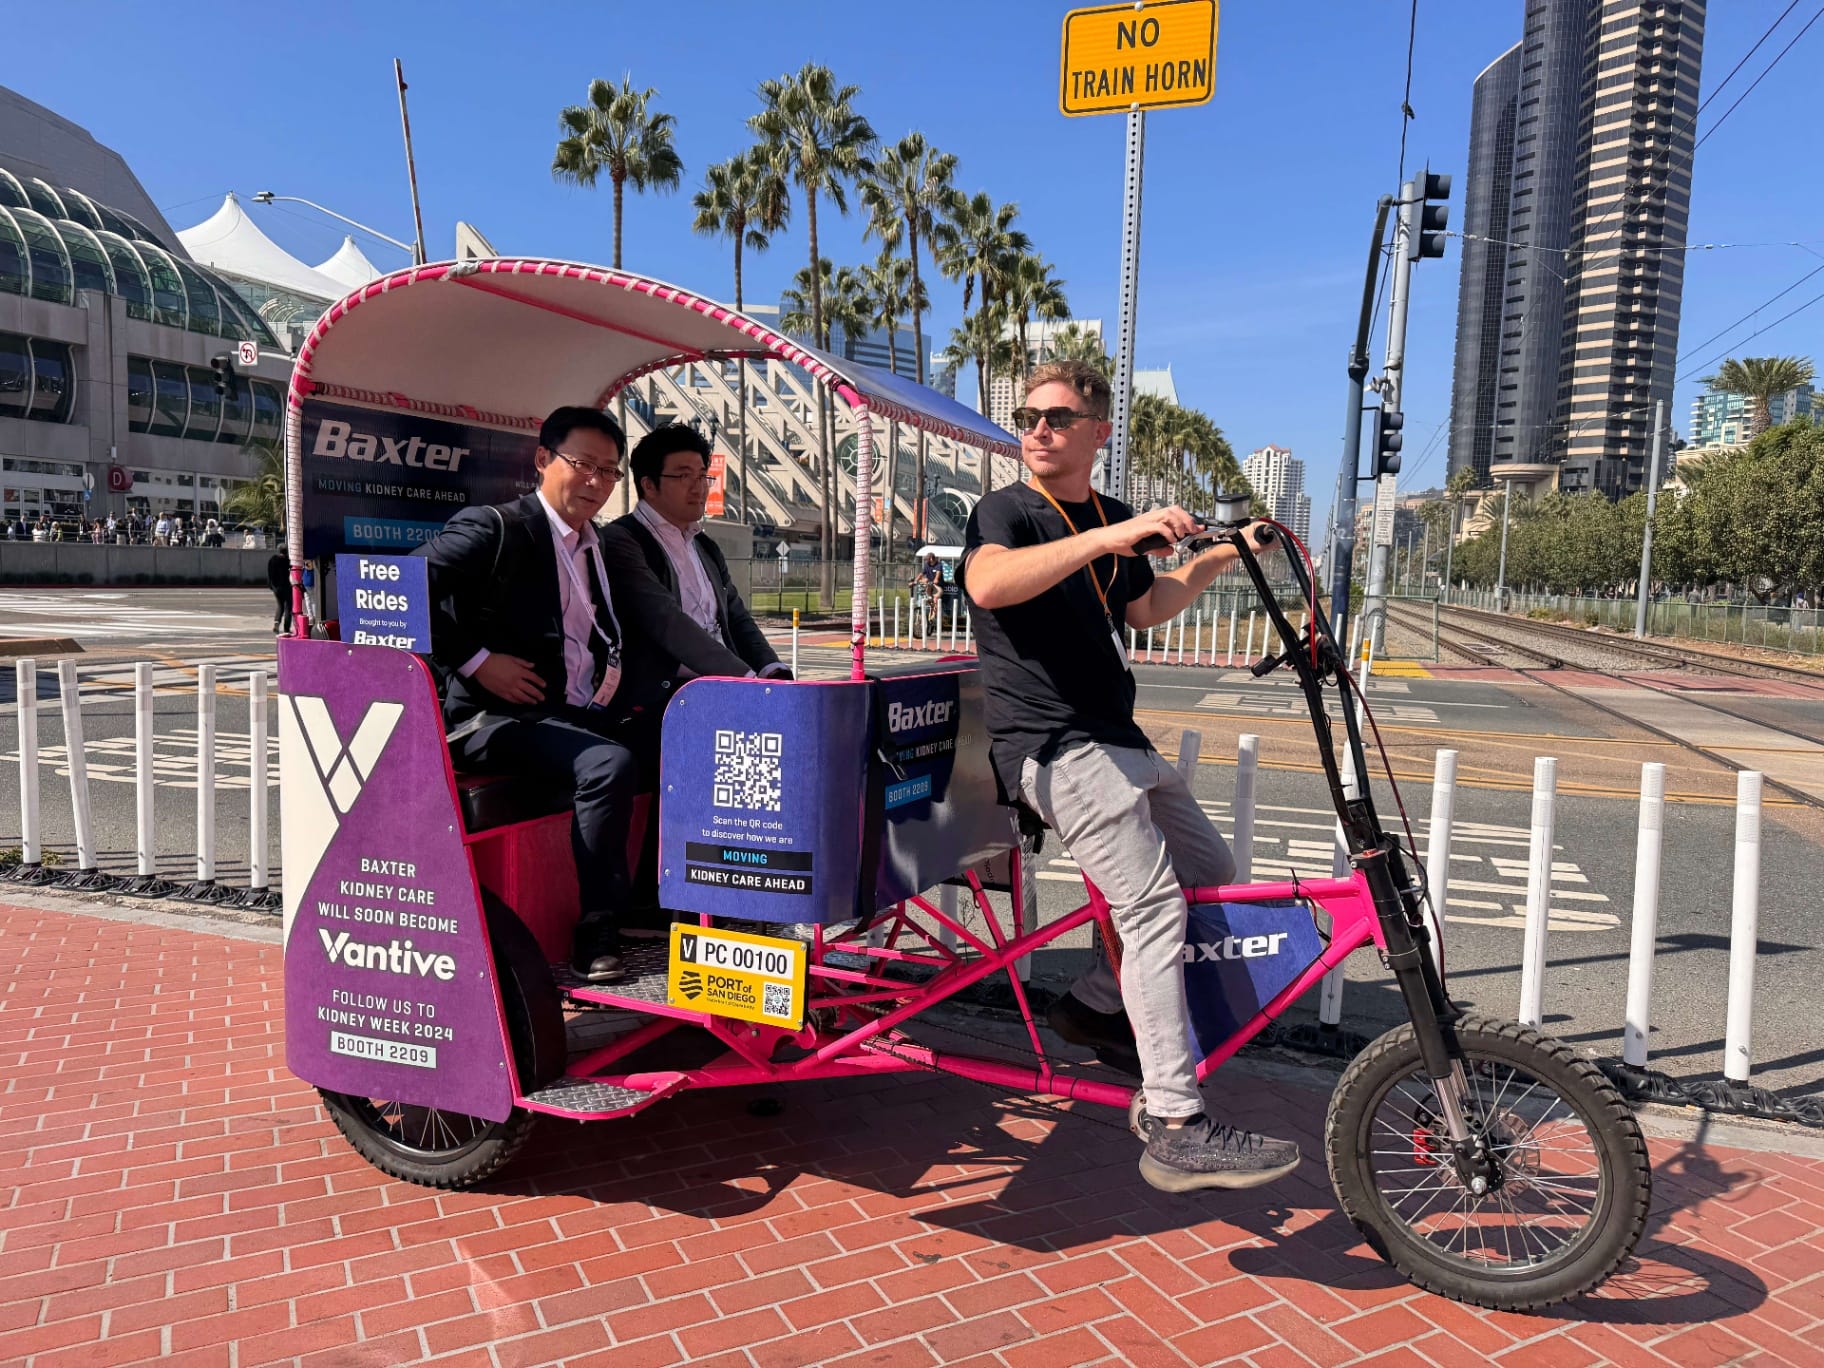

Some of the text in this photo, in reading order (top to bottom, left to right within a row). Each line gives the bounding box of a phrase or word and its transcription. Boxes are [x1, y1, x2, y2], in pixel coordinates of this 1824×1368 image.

[1117, 18, 1160, 50] NO
[1072, 58, 1206, 99] TRAIN HORN
[312, 419, 471, 472] Baxter
[113, 471, 122, 486] D
[318, 479, 466, 503] MOVING KIDNEY CARE AHEAD
[353, 524, 402, 540] BOOTH
[359, 559, 400, 581] Free
[355, 589, 408, 612] Rides
[388, 620, 399, 628] you
[400, 619, 408, 630] by
[354, 630, 416, 649] Baxter
[888, 700, 954, 733] Baxter
[915, 742, 938, 758] KIDNEY
[888, 781, 929, 802] BOOTH 2209
[713, 815, 783, 831] Scan the QR code
[702, 828, 793, 845] to discover how we are
[361, 858, 416, 878] BAXTER
[723, 849, 768, 865] MOVING
[691, 868, 806, 891] KIDNEY CARE AHEAD
[340, 880, 435, 905] KIDNEY CARE
[318, 902, 458, 934] WILL SOON BECOME
[318, 928, 456, 980] Vantive
[682, 938, 787, 975] V PC 00100
[707, 974, 752, 993] PORT of
[333, 989, 435, 1018] FOLLOW US TO
[707, 987, 726, 1000] SAN
[727, 992, 756, 1004] DIEGO
[318, 1006, 453, 1041] KIDNEY WEEK 2024
[337, 1036, 429, 1063] BOOTH 2209
